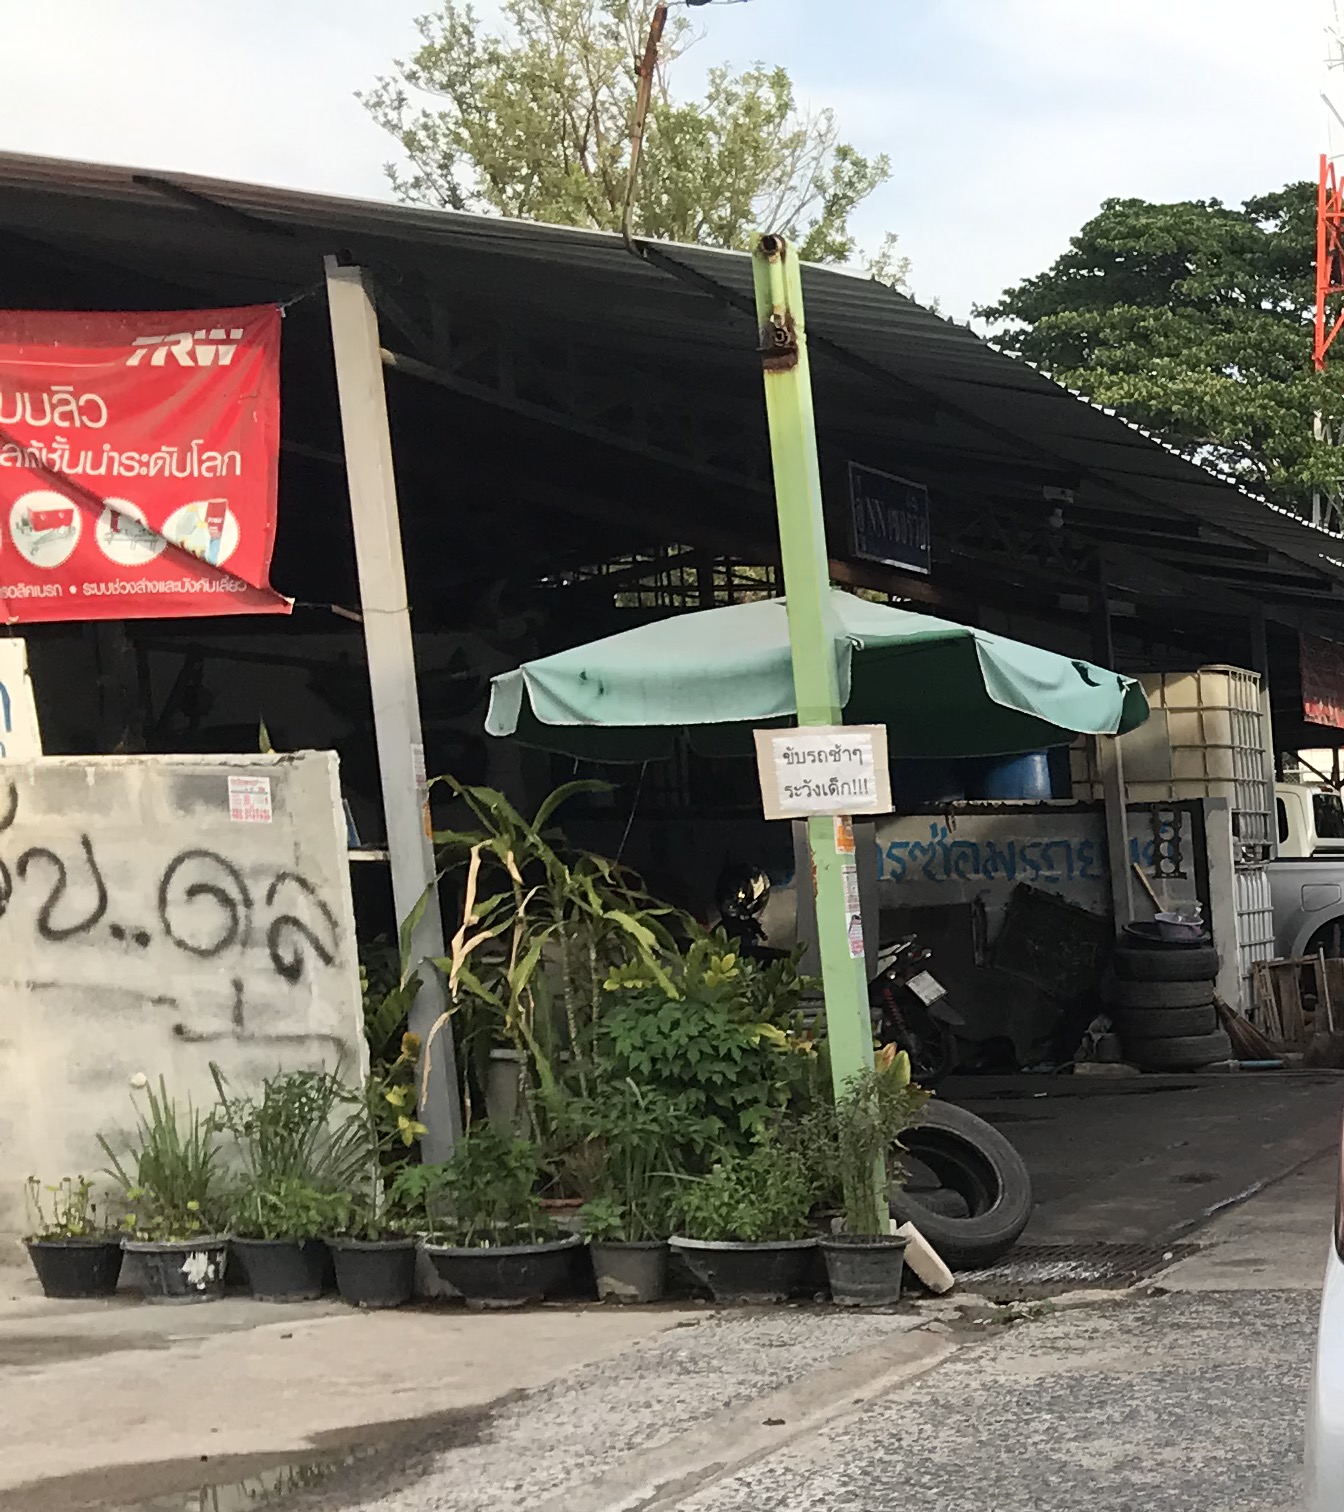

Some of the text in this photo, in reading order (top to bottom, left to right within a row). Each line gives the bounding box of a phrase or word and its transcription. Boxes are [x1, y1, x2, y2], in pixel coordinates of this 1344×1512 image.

[126, 328, 244, 367] TRW
[782, 744, 863, 766] ขับรถช้าๆ
[784, 777, 869, 799] ระวังเด็ก!!!
